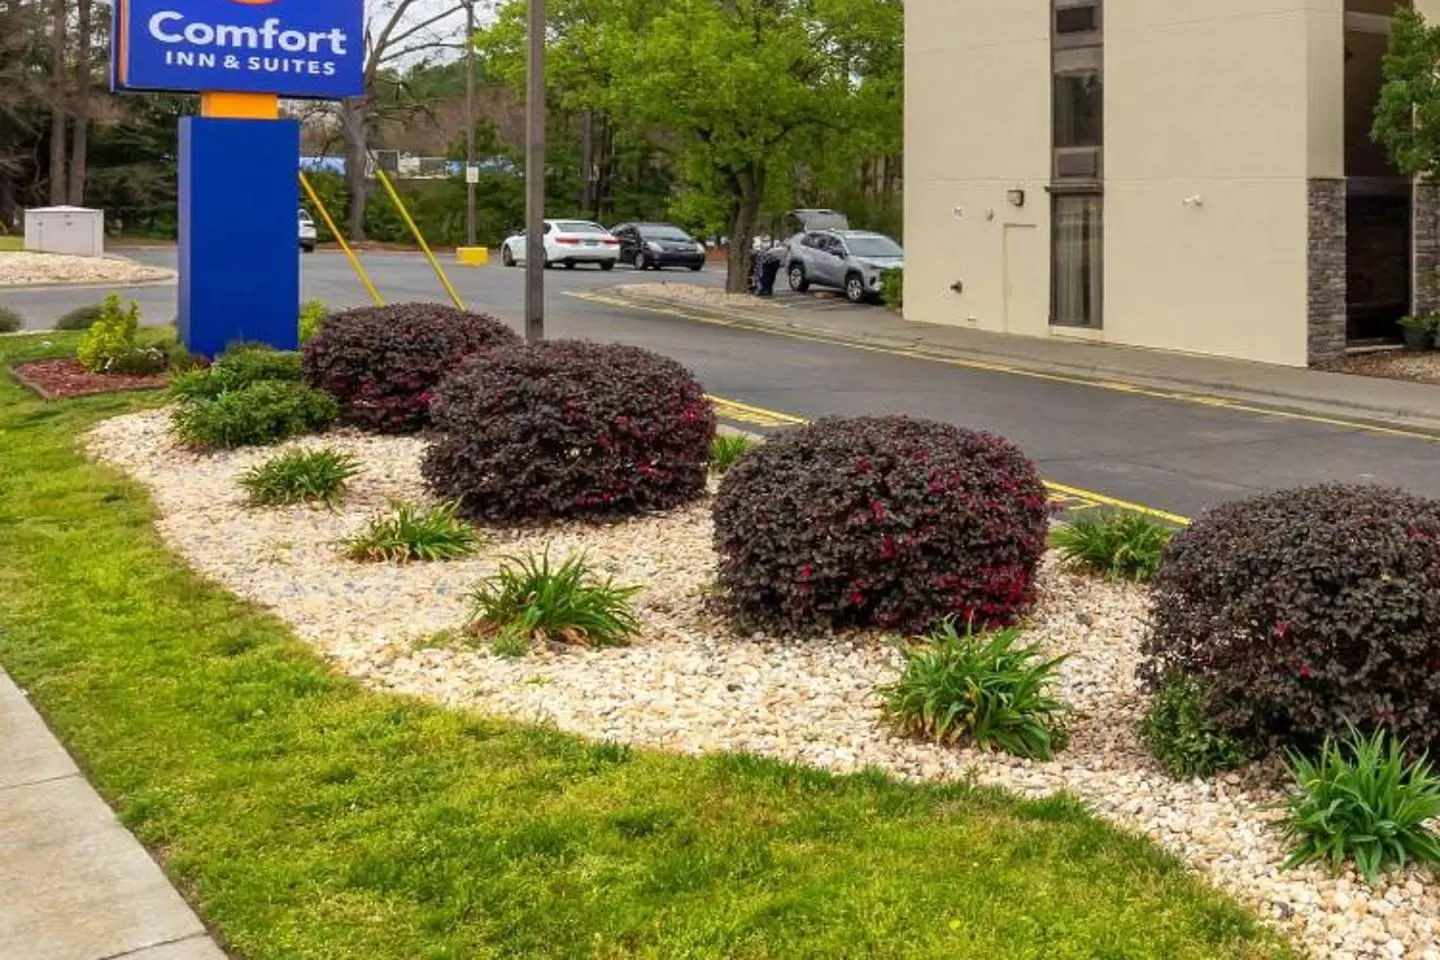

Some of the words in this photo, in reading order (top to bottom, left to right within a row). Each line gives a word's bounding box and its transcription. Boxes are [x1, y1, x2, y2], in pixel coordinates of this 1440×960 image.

[149, 10, 347, 55] Comfort
[165, 50, 216, 68] INN
[223, 55, 241, 70] &
[247, 56, 336, 76] SUITES
